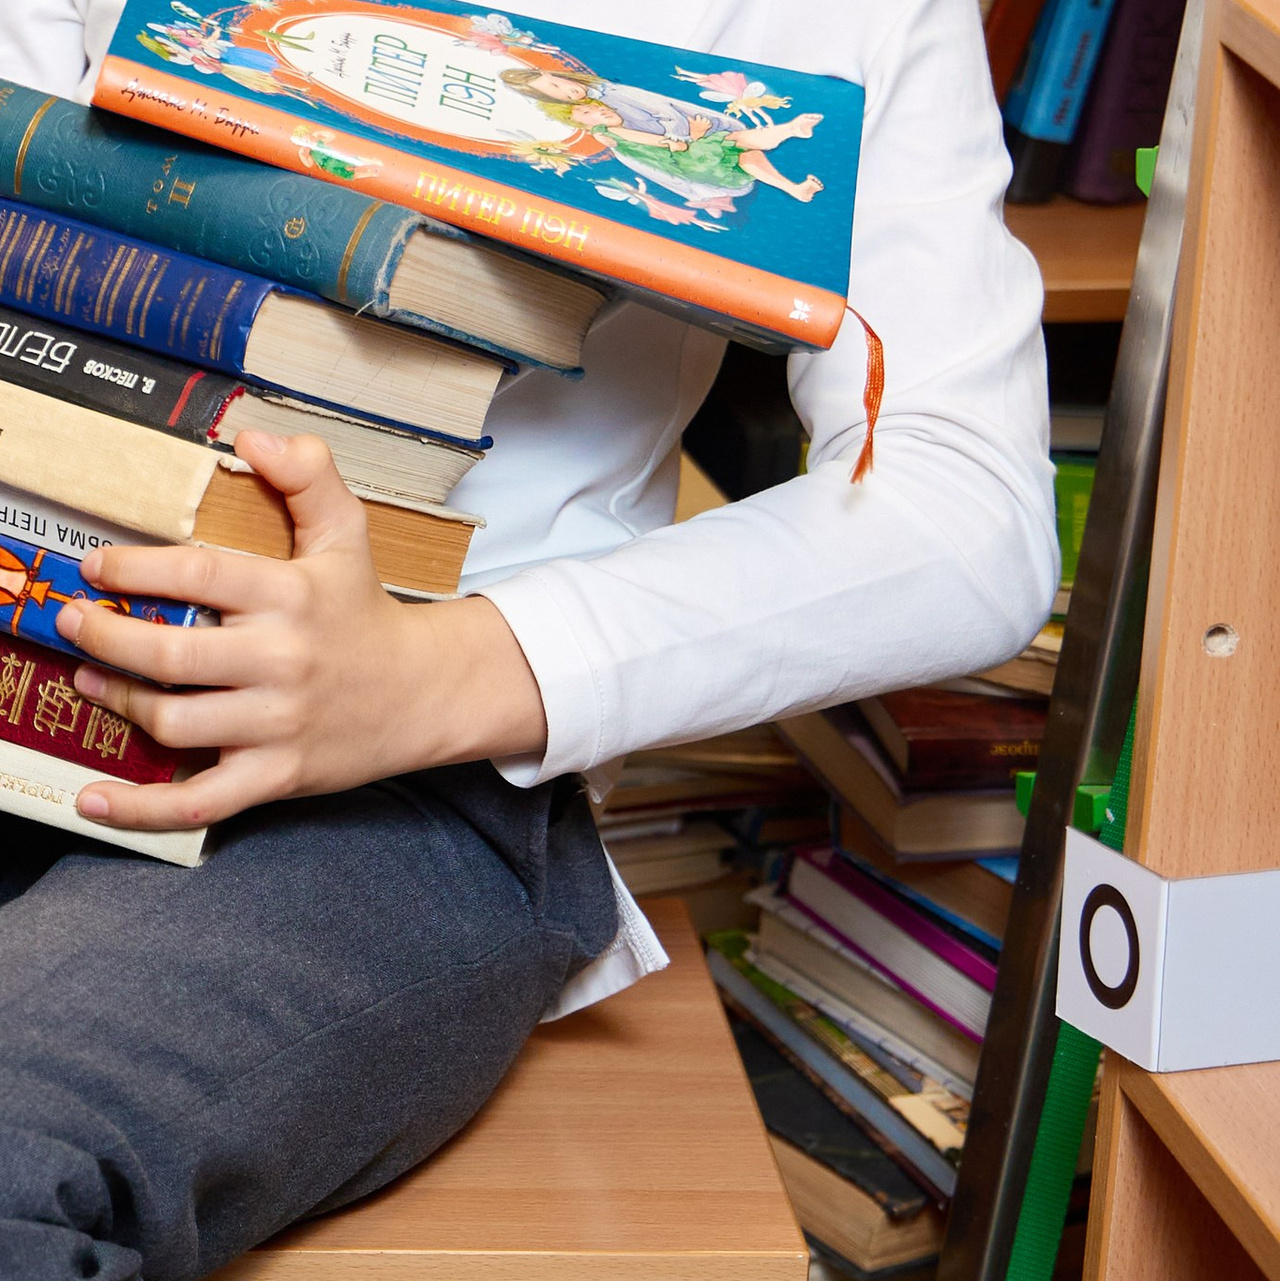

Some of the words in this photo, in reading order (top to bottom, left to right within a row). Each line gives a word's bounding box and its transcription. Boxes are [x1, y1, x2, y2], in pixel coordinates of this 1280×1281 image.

[364, 34, 432, 108] ПИТЕР
[439, 63, 497, 121] ПЭН
[118, 75, 189, 120] Джеймс
[189, 97, 211, 120] М.
[211, 105, 263, 143] Барри
[146, 156, 178, 213] ТОМ
[410, 170, 518, 229] ПИТЕР
[518, 206, 591, 254] ПЭН
[81, 357, 139, 389] ПЕСКОВ
[139, 375, 156, 394] В.
[50, 522, 113, 558] ЬМА
